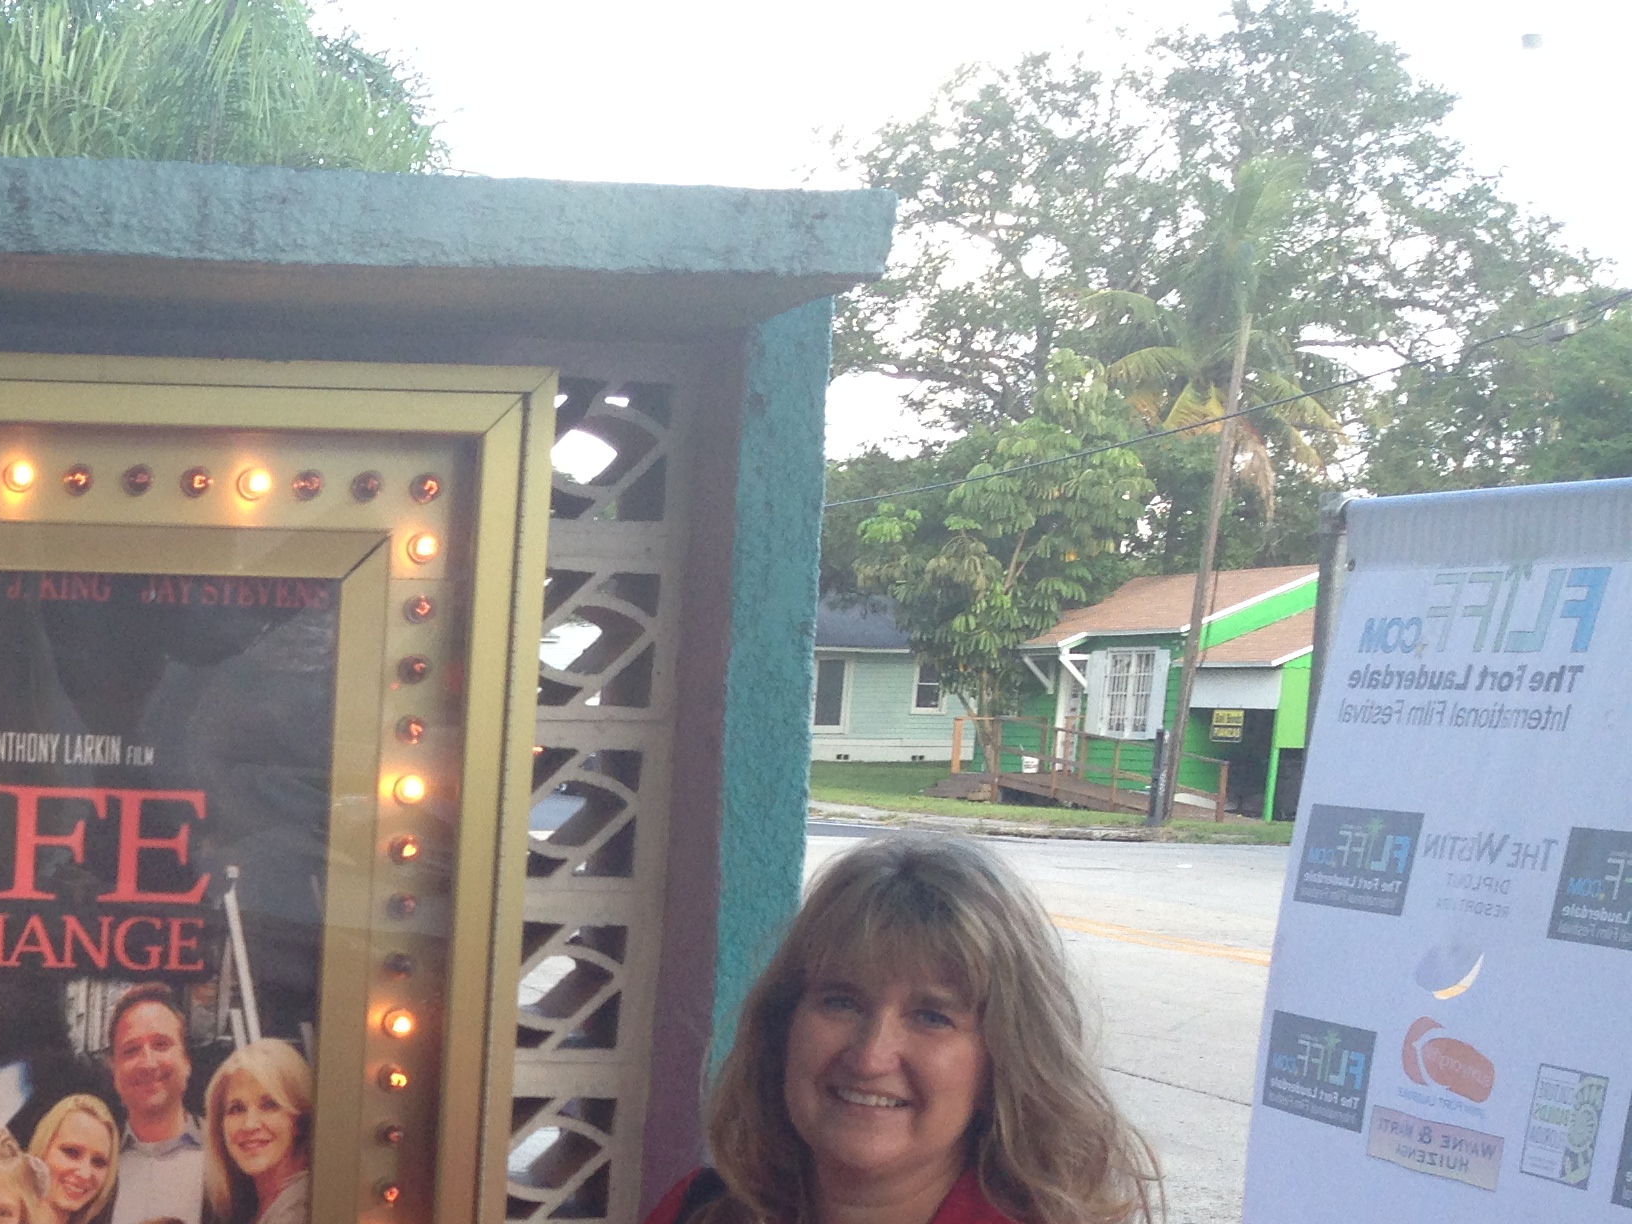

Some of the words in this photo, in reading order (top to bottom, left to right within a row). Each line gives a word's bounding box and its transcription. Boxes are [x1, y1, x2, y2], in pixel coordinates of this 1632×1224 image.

[39, 572, 113, 602] KING
[64, 733, 123, 764] LARKIN
[125, 745, 156, 767] FILM
